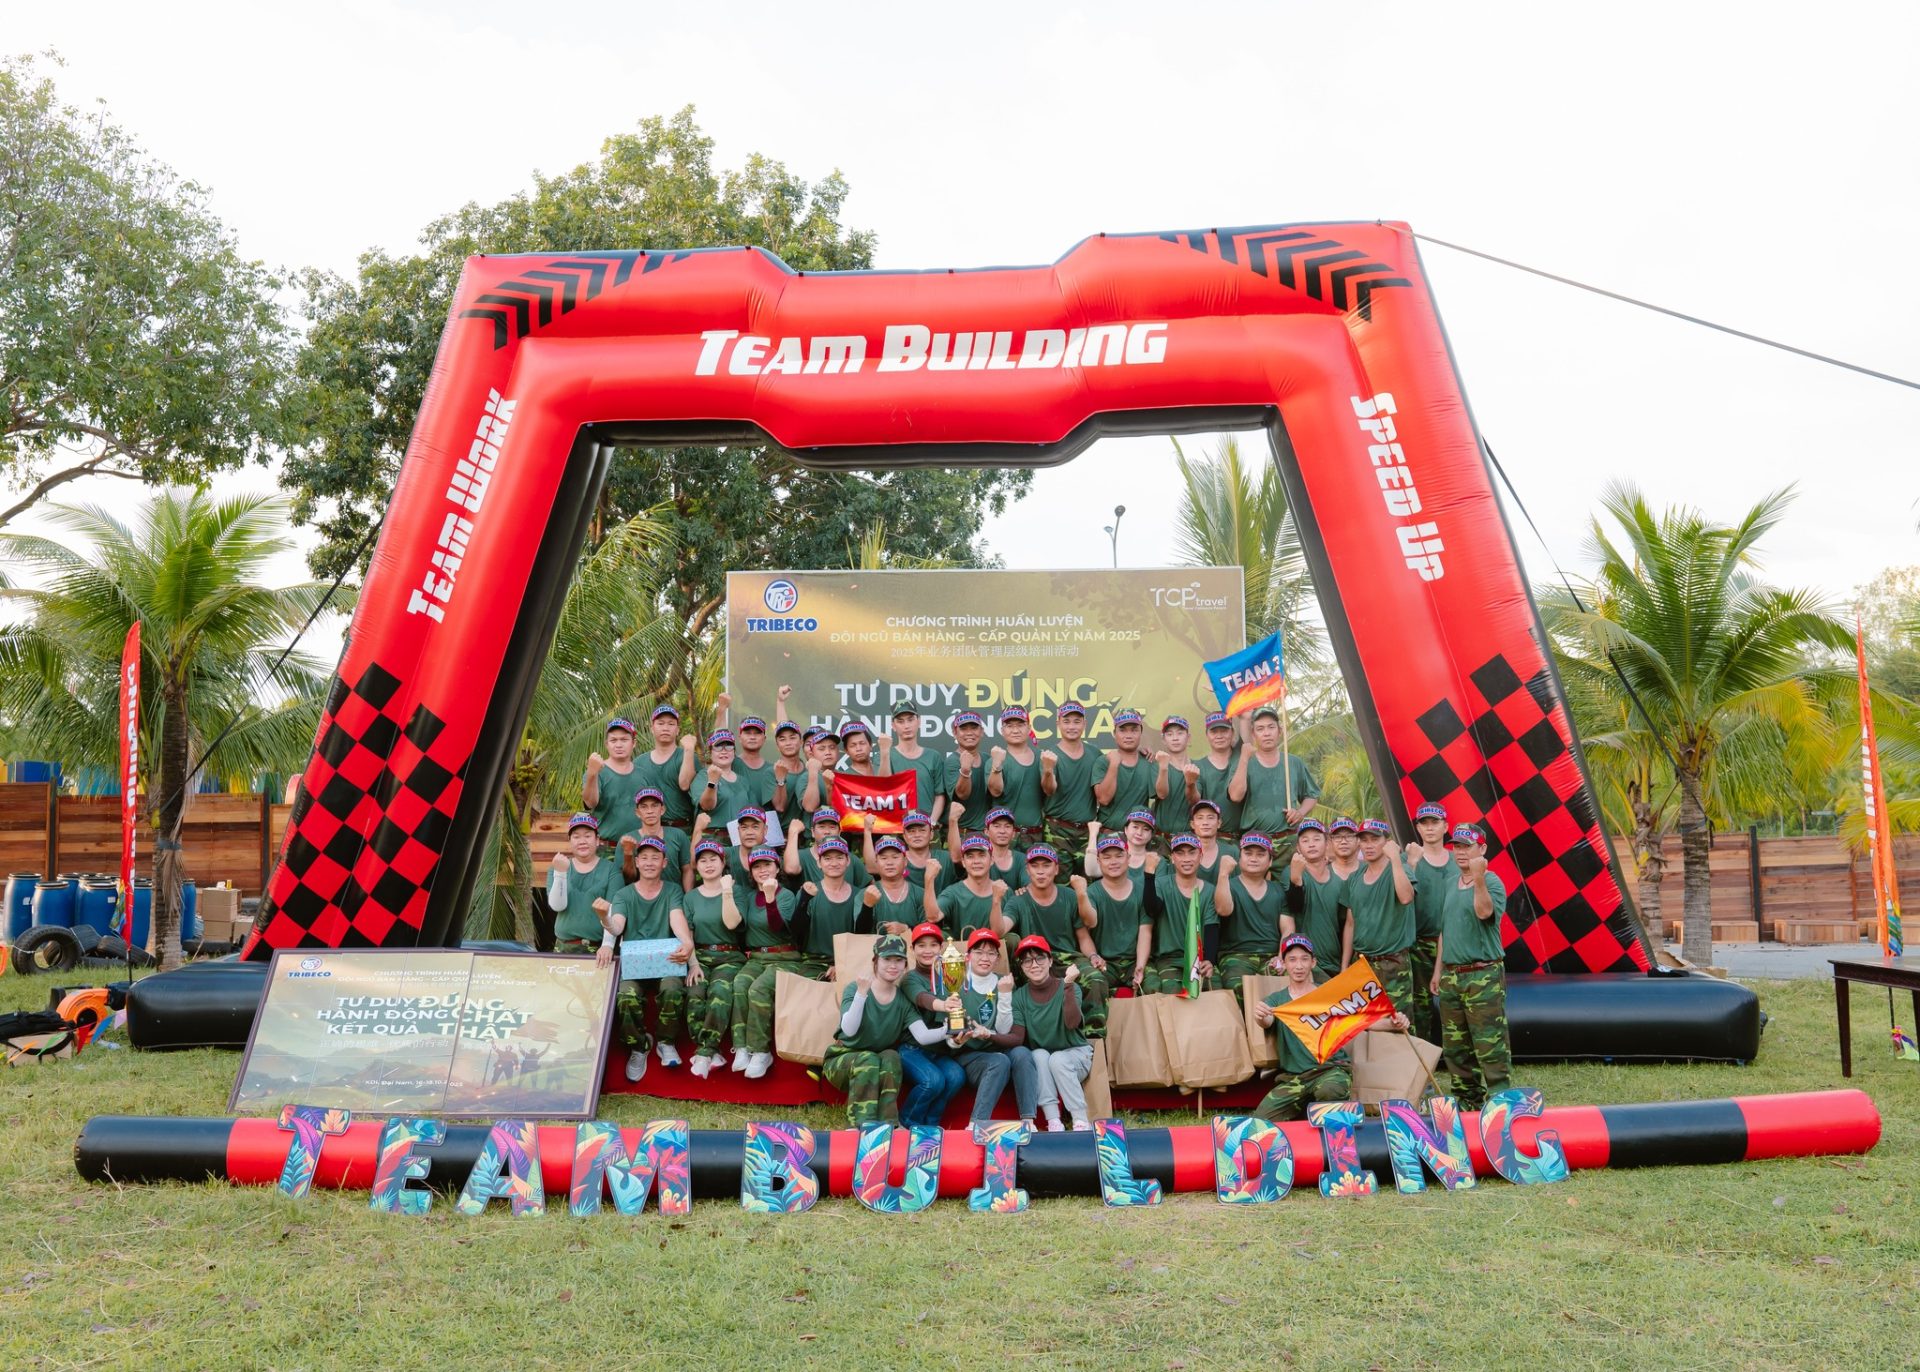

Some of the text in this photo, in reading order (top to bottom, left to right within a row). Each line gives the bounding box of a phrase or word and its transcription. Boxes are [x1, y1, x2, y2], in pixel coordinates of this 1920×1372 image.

[1196, 596, 1227, 606] travel
[747, 618, 818, 632] TRIBECO
[886, 613, 1084, 628] CHƯƠNG TRÌNH HUẤN LUYỆN
[830, 630, 855, 644] ĐỘI
[858, 631, 889, 642] NGŨ
[892, 630, 922, 642] BÁN
[925, 630, 966, 642] HÀNG
[978, 629, 1007, 642] CẤP
[1010, 629, 1051, 643] QUẢN
[1054, 629, 1070, 641] LÝ
[1074, 629, 1106, 641] NĂM
[1109, 630, 1141, 641] 2025
[1220, 660, 1272, 692] TEAM
[834, 669, 1098, 708] TƯ DUY ĐÚNG
[841, 793, 908, 811] TEAM 1
[1362, 980, 1384, 1001] 2
[336, 992, 505, 1011] TƯ DUY ĐÚNG
[316, 1006, 535, 1024] HÀNH ĐỘNG CHẤT
[327, 1020, 519, 1043] KẾT QUẢ THẬT
[278, 1087, 1571, 1217] TEAM BUILDING
